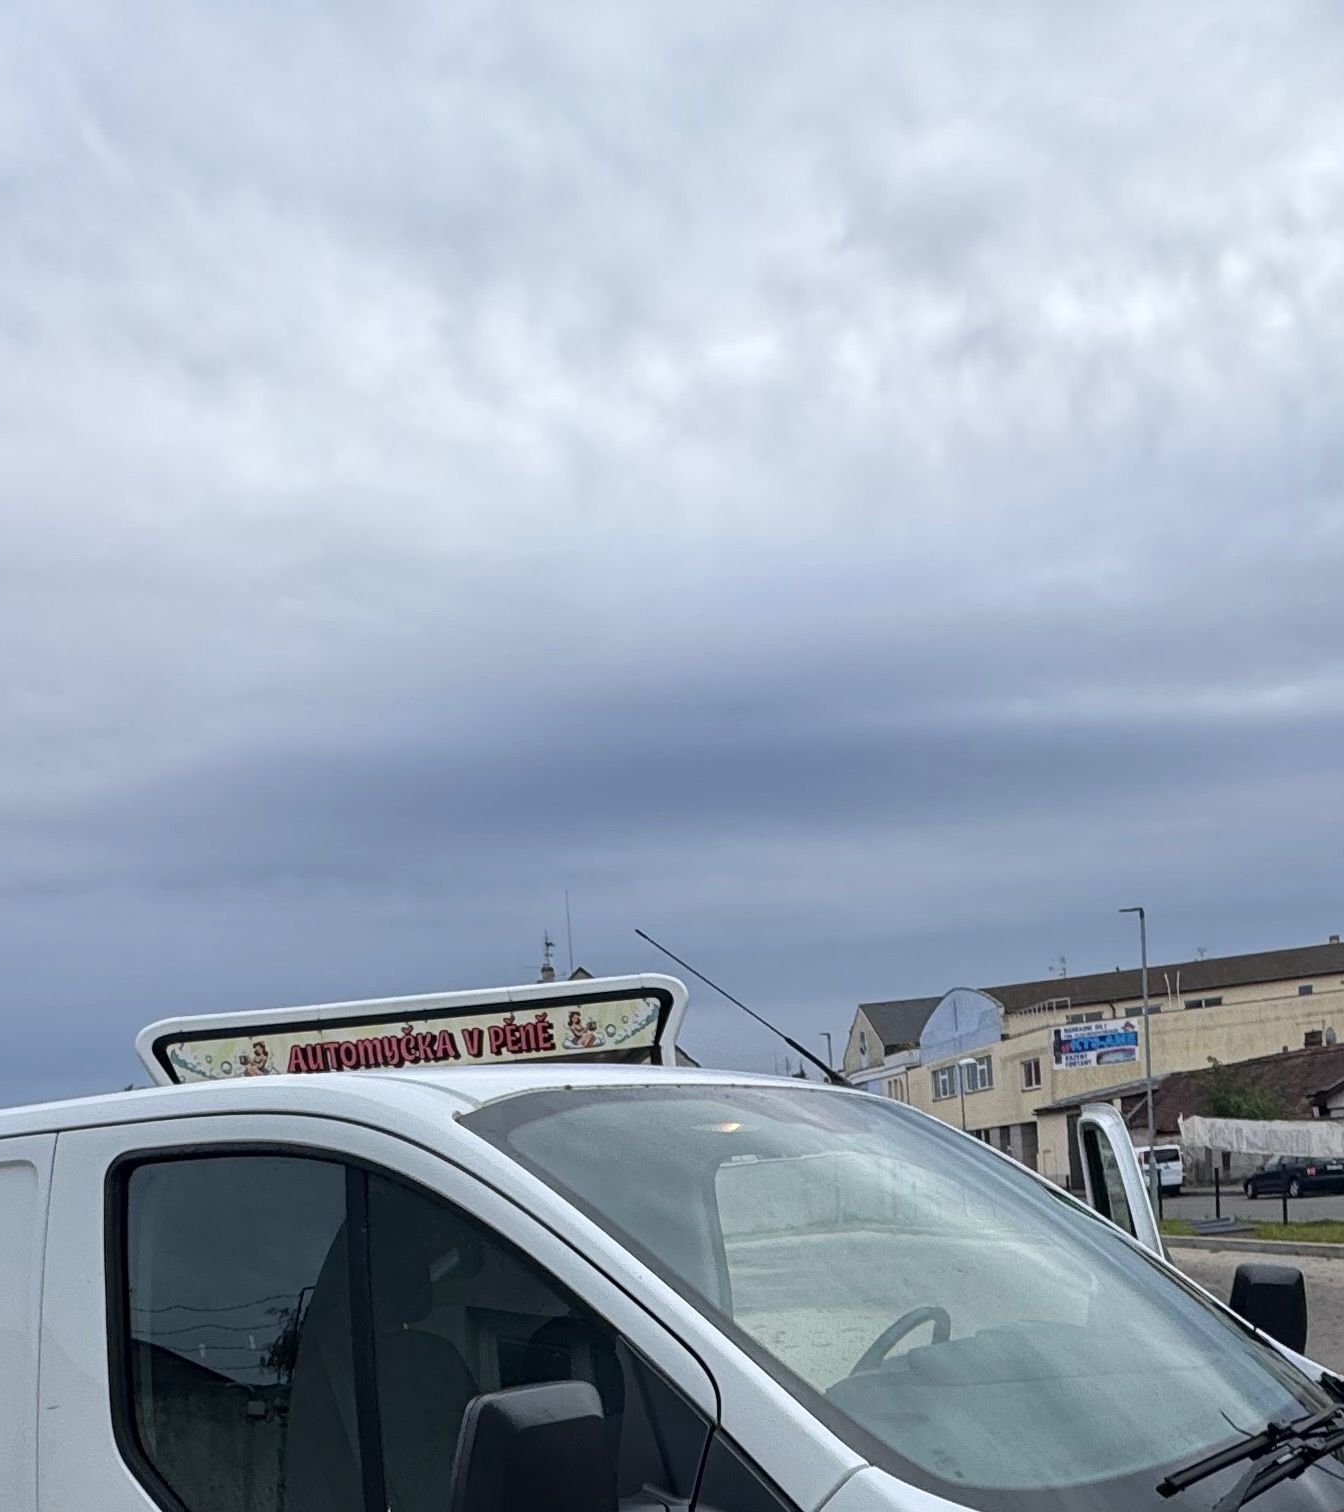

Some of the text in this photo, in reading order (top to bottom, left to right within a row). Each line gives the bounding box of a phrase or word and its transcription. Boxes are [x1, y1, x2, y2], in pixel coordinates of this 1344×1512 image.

[288, 1012, 556, 1073] AUTOMYČKA V PĚNĚ
